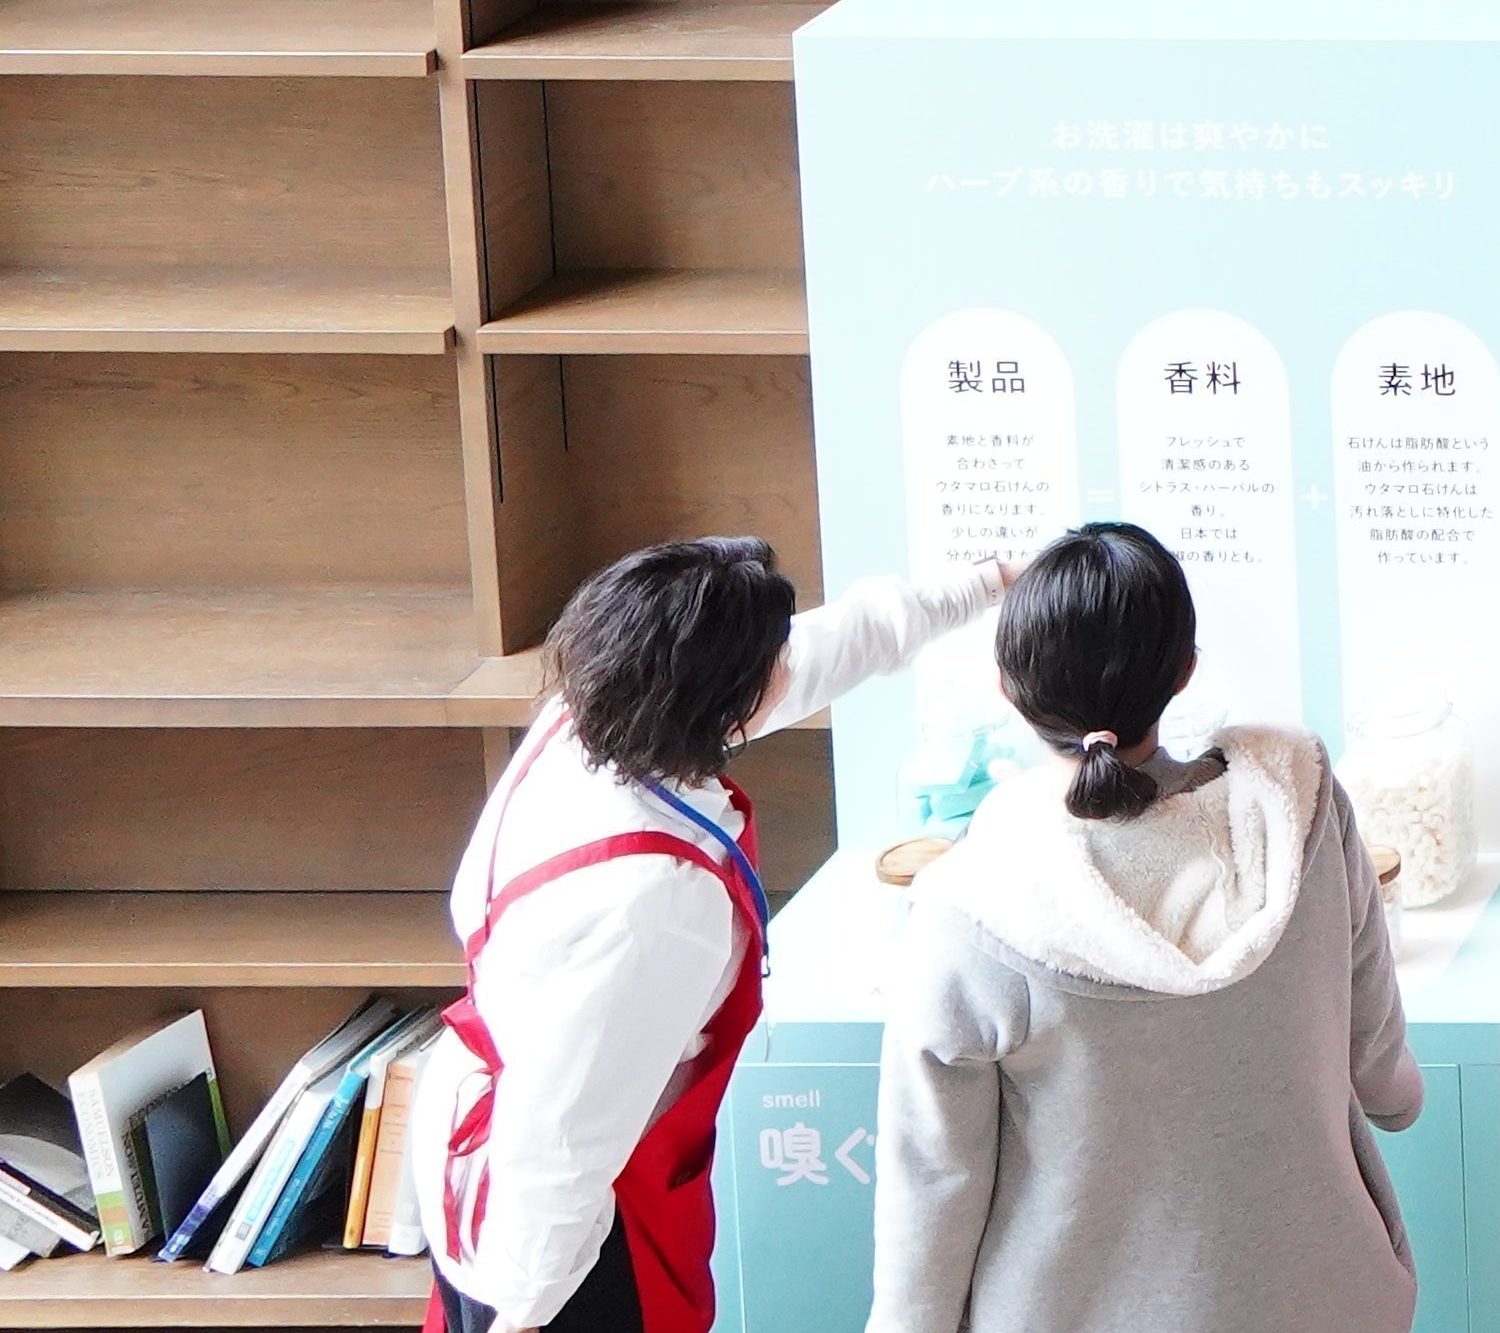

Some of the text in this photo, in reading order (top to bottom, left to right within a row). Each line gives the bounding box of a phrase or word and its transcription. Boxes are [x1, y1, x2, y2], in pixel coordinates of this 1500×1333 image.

[1050, 119, 1330, 152] お洗濯は爽やかに
[948, 359, 1025, 395] 製品
[1163, 361, 1241, 396] 香料
[1377, 362, 1457, 397] 素地
[761, 1090, 821, 1109] smell
[758, 1121, 876, 1187] 嗅ぐ
